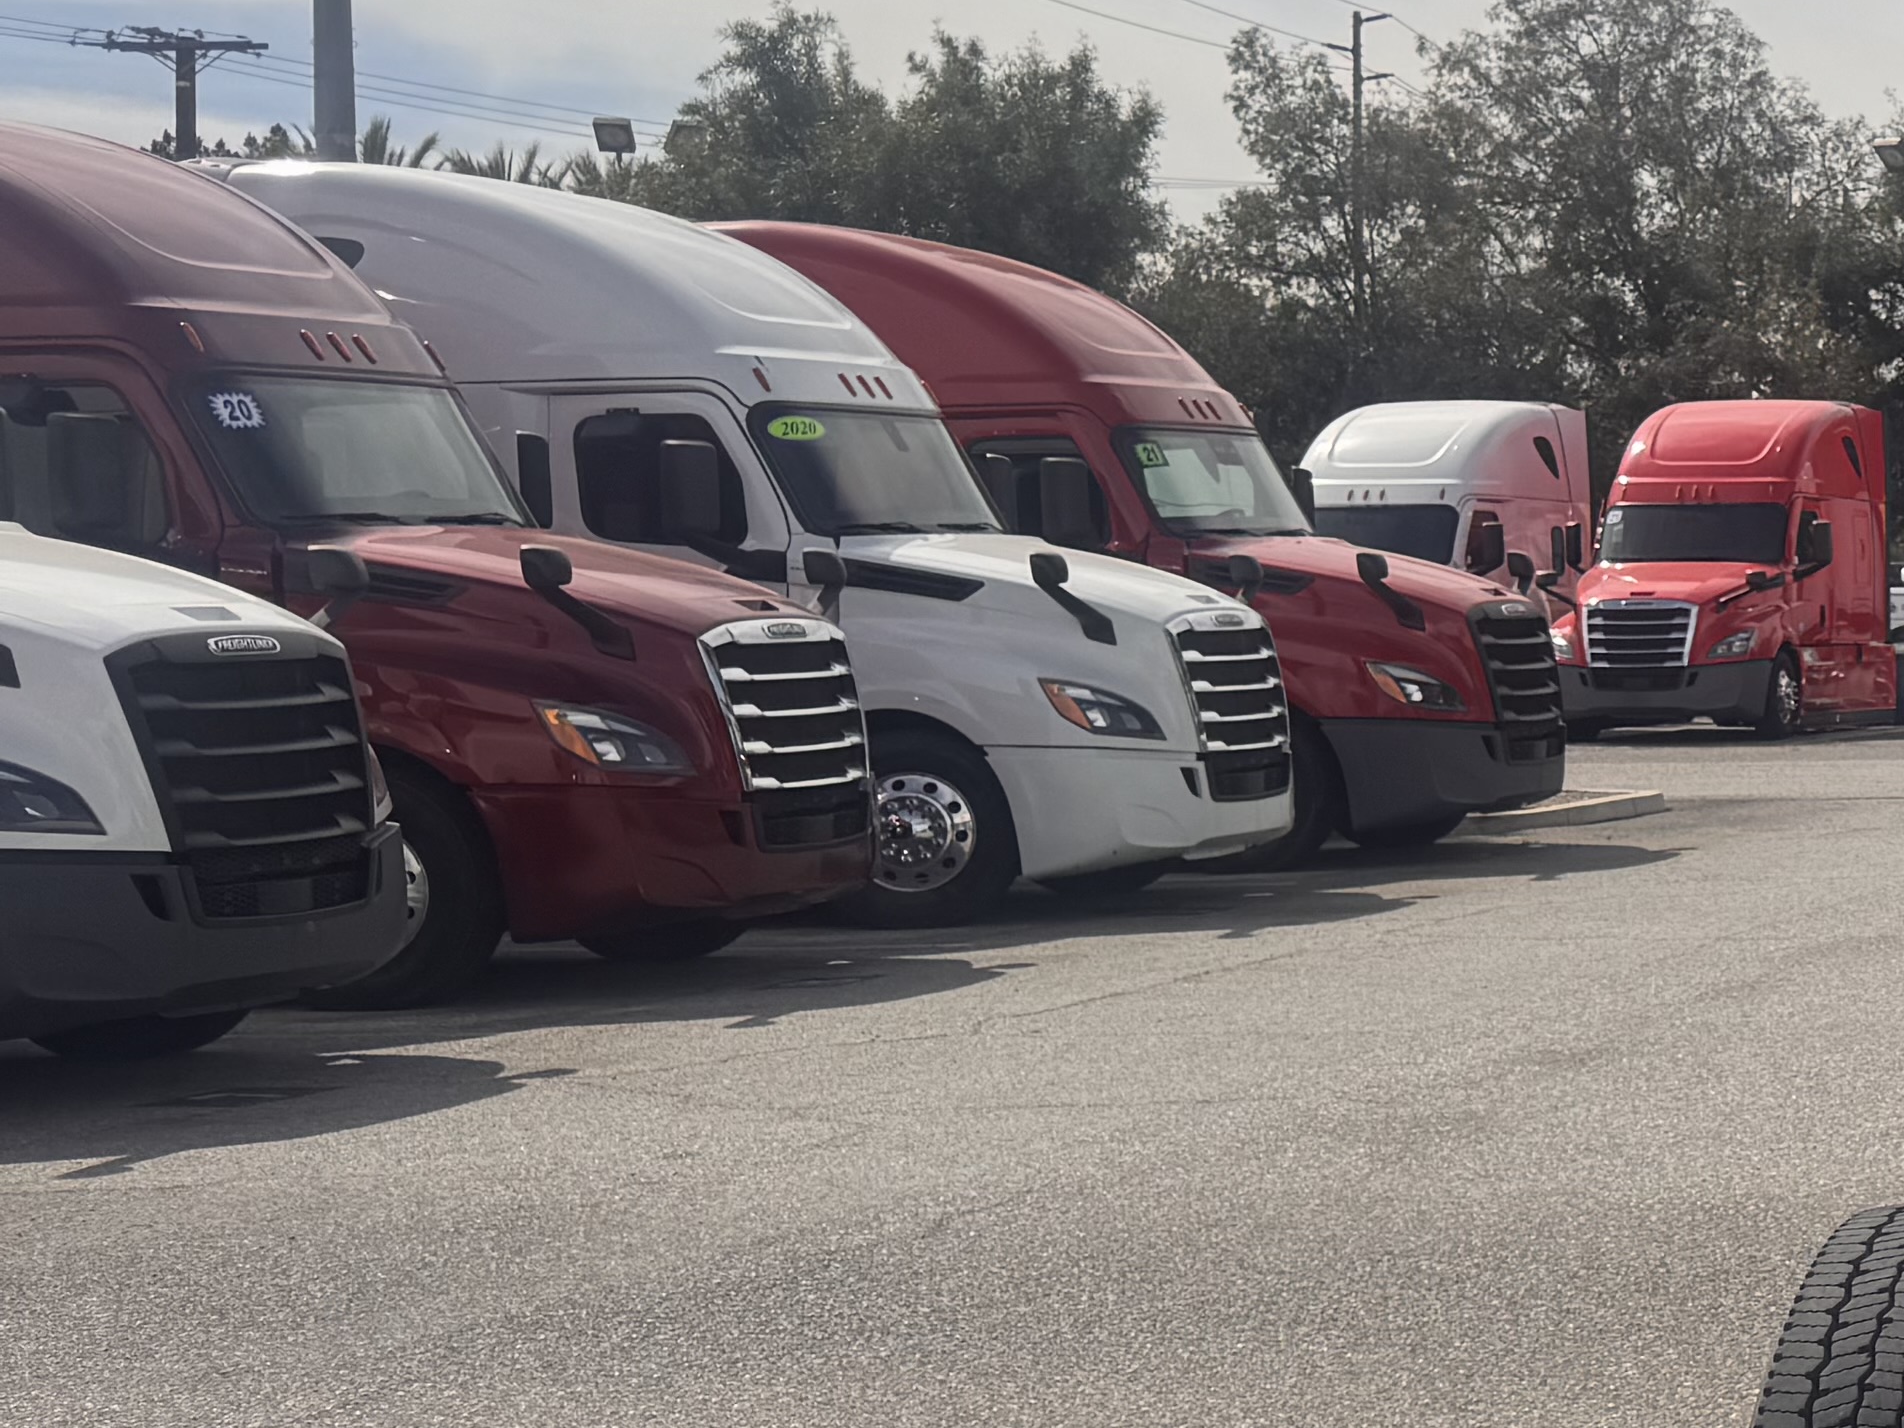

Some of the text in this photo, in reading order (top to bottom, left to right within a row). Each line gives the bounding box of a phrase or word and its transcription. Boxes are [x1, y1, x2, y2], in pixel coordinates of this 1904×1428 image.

[223, 399, 253, 421] 20
[781, 421, 817, 436] 2020
[1142, 445, 1160, 462] 21
